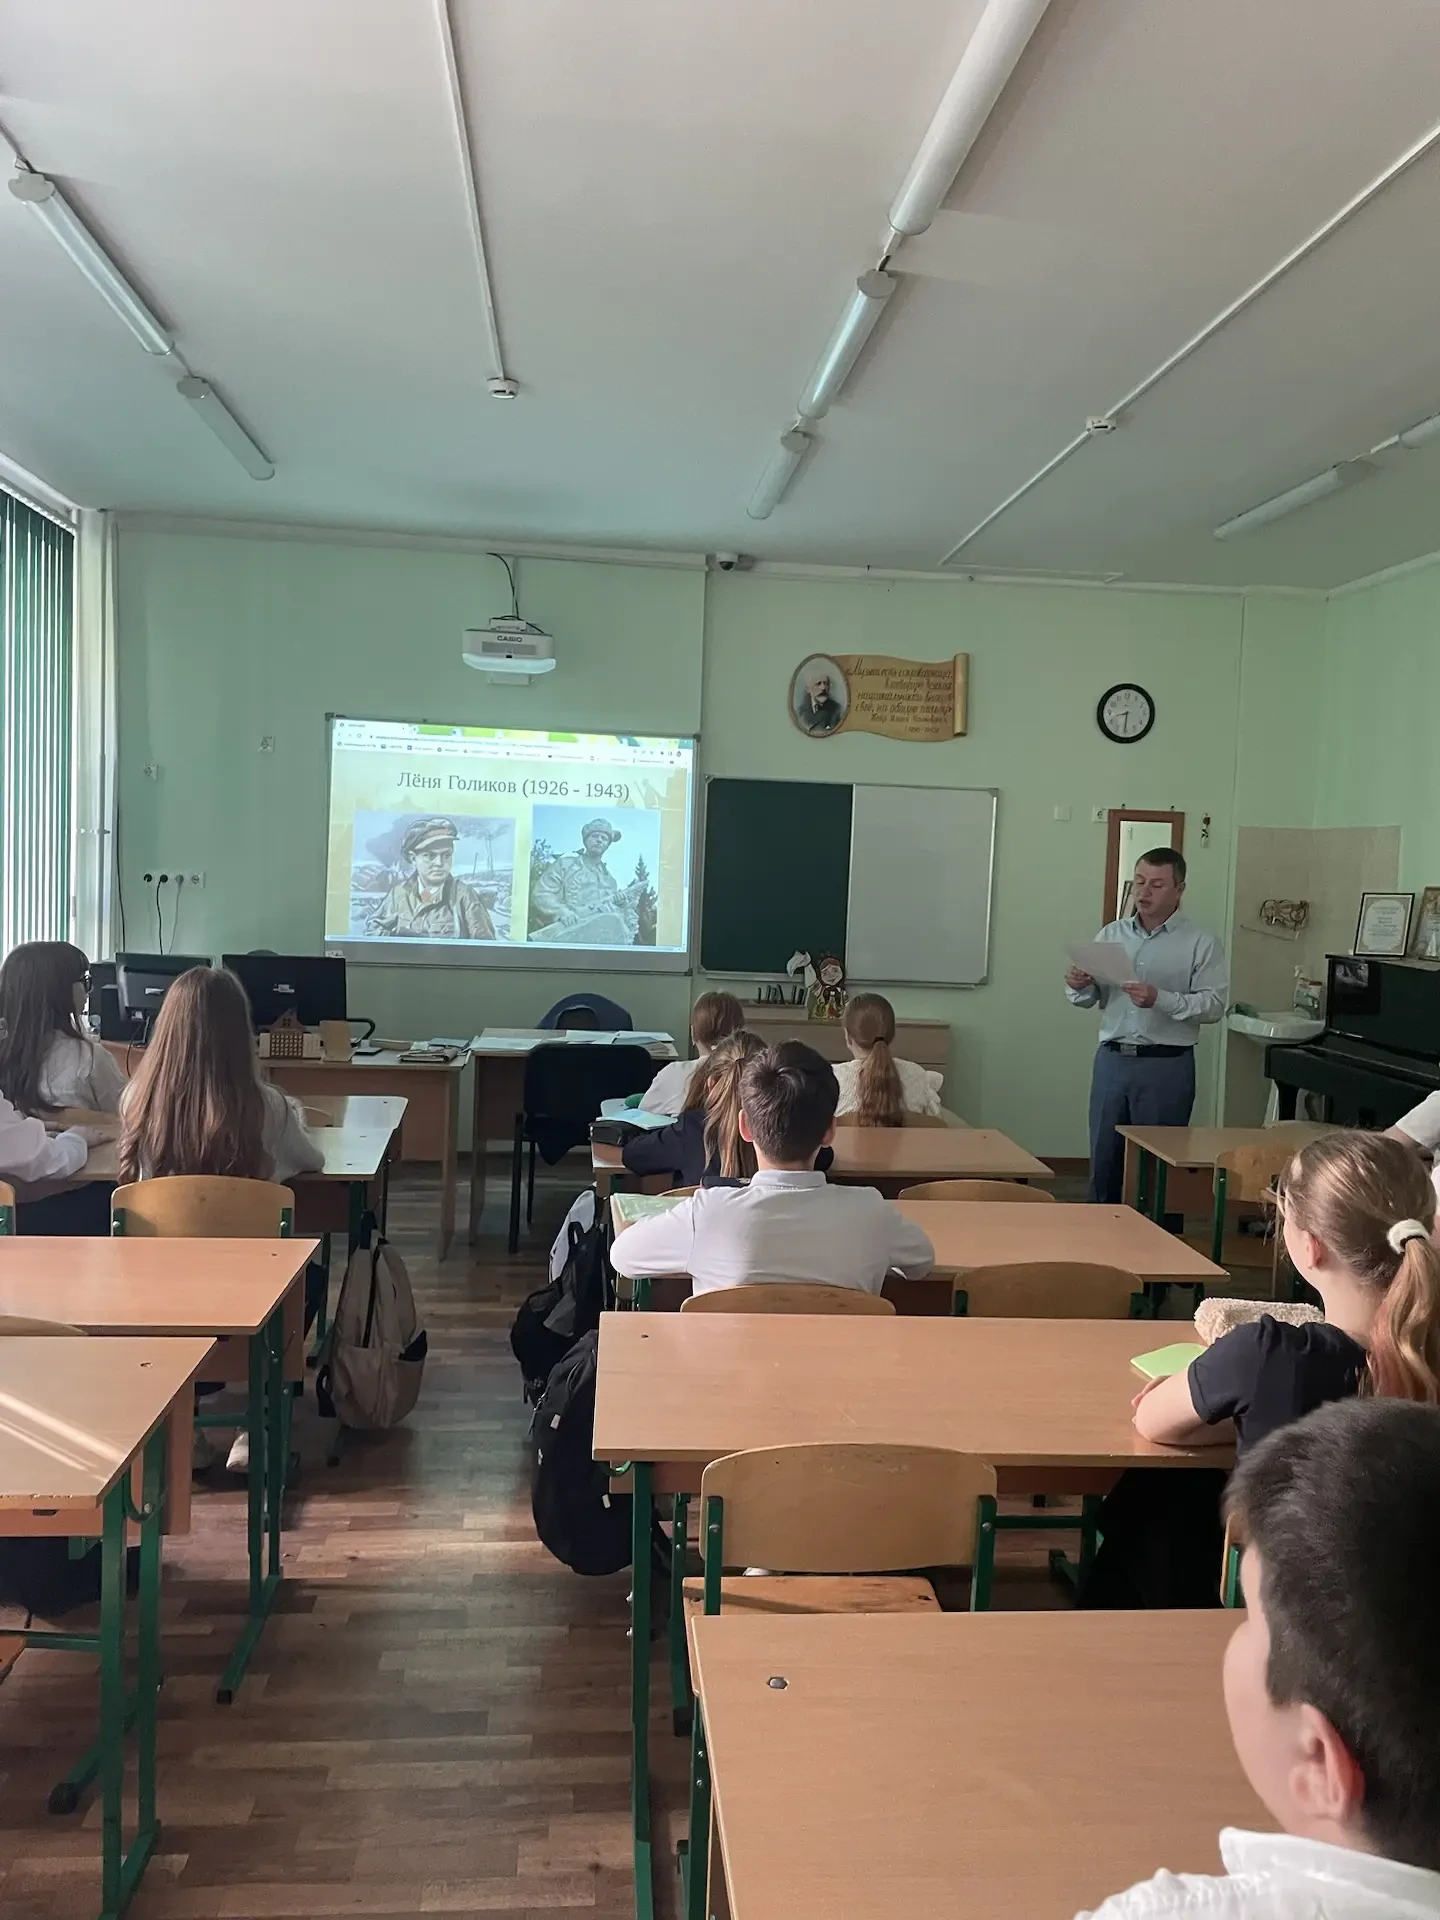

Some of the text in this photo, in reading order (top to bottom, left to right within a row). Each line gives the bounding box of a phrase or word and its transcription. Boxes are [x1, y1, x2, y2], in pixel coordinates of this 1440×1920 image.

[496, 635, 523, 643] CASIO
[397, 772, 442, 788] Лёня
[448, 775, 517, 793] Голиков
[522, 779, 569, 797] (1926
[586, 782, 630, 802] 1943)
